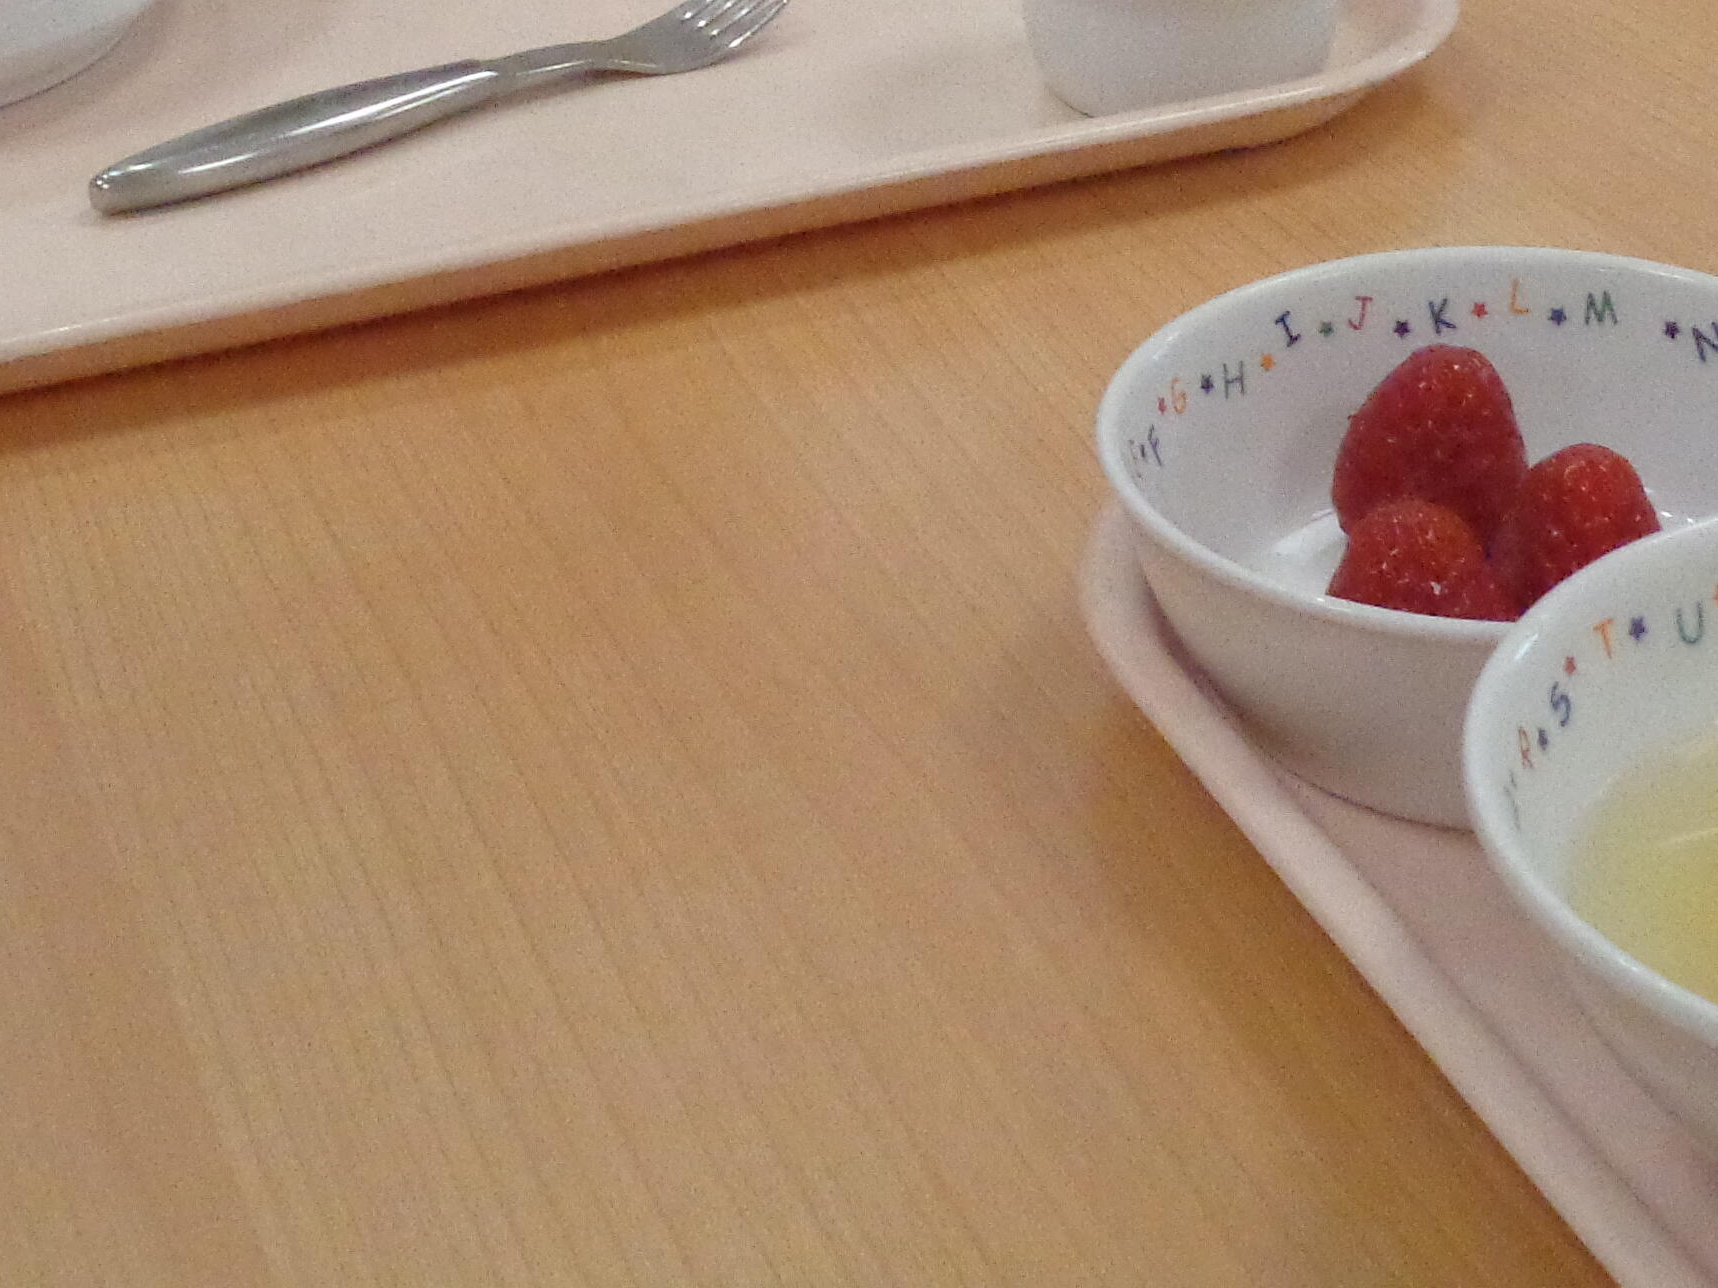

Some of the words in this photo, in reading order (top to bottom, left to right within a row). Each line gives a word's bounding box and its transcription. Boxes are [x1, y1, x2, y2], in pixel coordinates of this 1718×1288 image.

[1223, 360, 1244, 399] H
[1275, 310, 1301, 347] I
[1348, 296, 1373, 330] J
[1429, 297, 1457, 334] K
[1510, 280, 1531, 314] L
[1585, 290, 1618, 325] M
[1518, 726, 1534, 769] R
[1550, 681, 1571, 727] S
[1593, 617, 1614, 659] T
[1674, 602, 1704, 645] U
